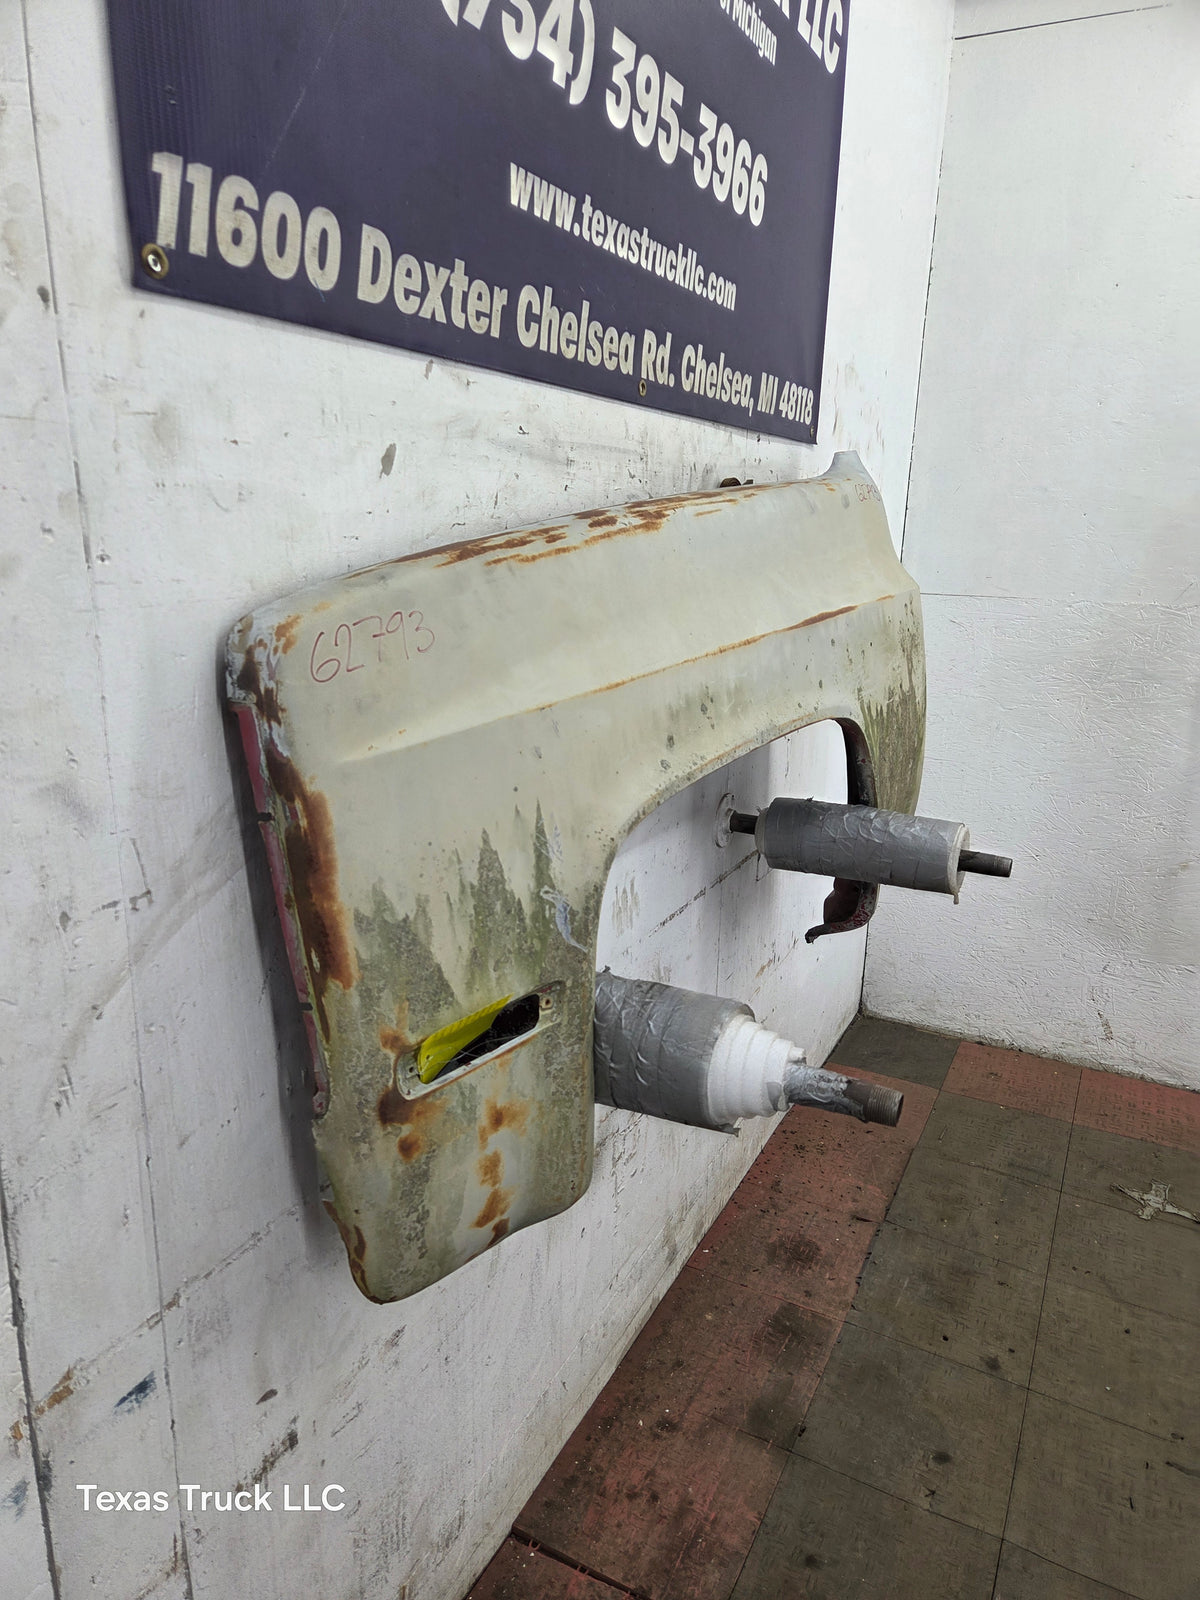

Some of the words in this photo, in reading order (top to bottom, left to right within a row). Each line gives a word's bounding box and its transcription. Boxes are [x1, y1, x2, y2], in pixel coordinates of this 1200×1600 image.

[732, 0, 777, 66] Michigan
[441, 0, 596, 105] 34)
[606, 26, 768, 226] 395-3966
[151, 151, 342, 291] 11600
[356, 223, 508, 339] Dexter
[516, 284, 636, 376] Chelsea
[641, 328, 675, 388] Rd.
[681, 343, 754, 417] Chelsea,
[757, 371, 779, 415] MI
[779, 380, 814, 425] 48118
[509, 162, 737, 312] www.texastruckllc.com
[310, 610, 435, 683] 62793
